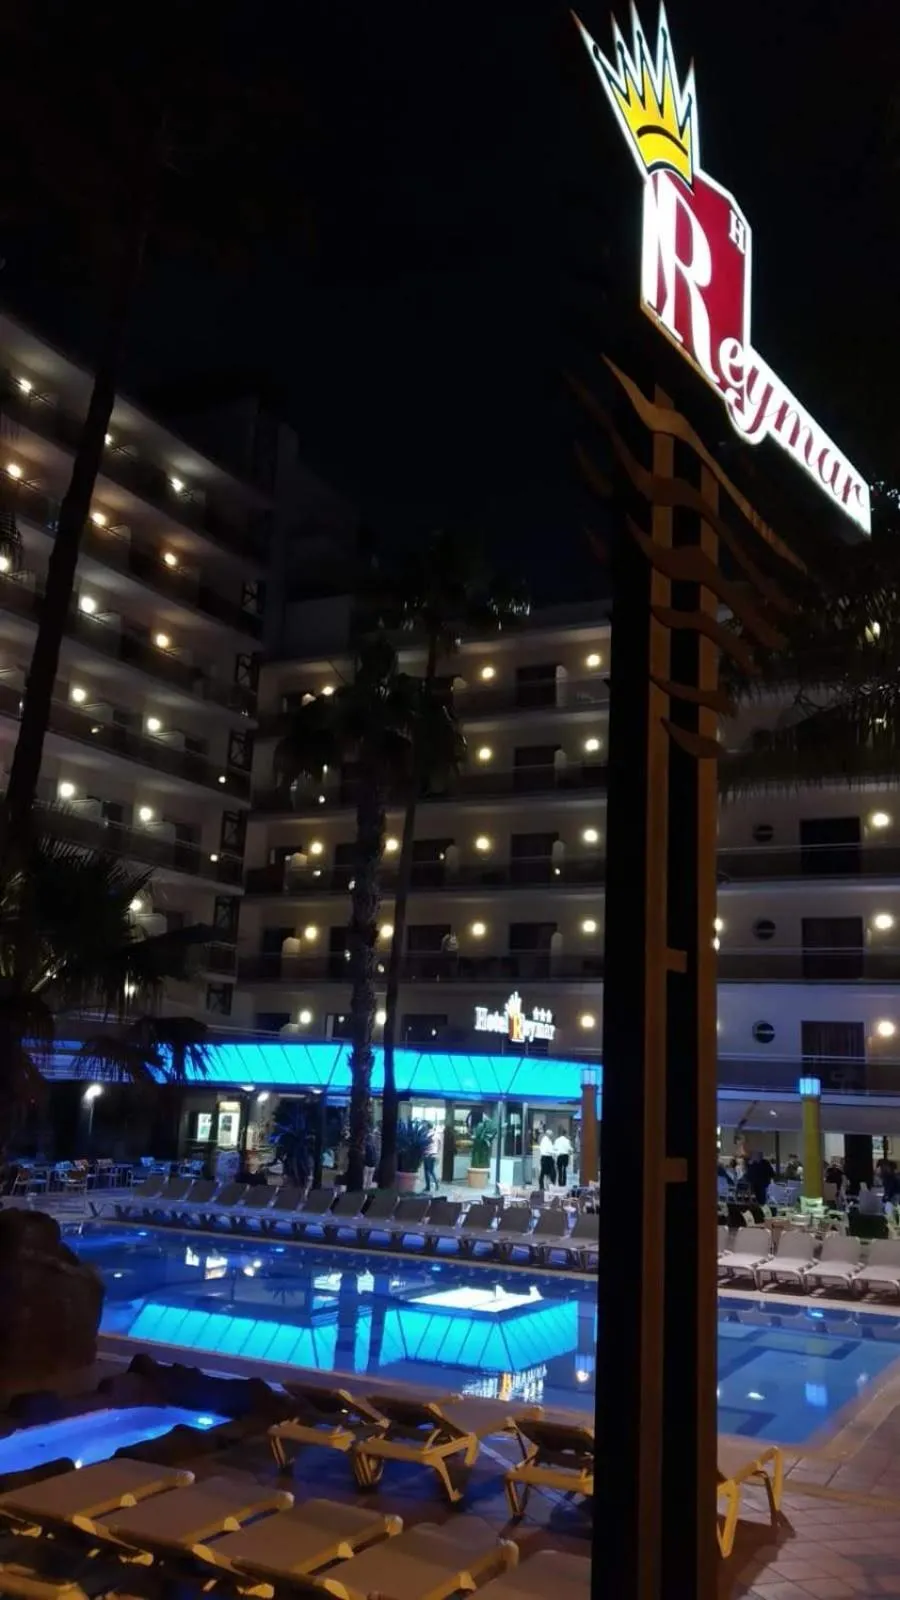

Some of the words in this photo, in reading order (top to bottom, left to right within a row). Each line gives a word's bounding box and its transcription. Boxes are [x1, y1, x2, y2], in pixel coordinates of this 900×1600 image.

[729, 210, 746, 254] H
[644, 170, 866, 509] Reymar
[475, 1007, 509, 1034] Hotel
[511, 1015, 556, 1043] Reymar
